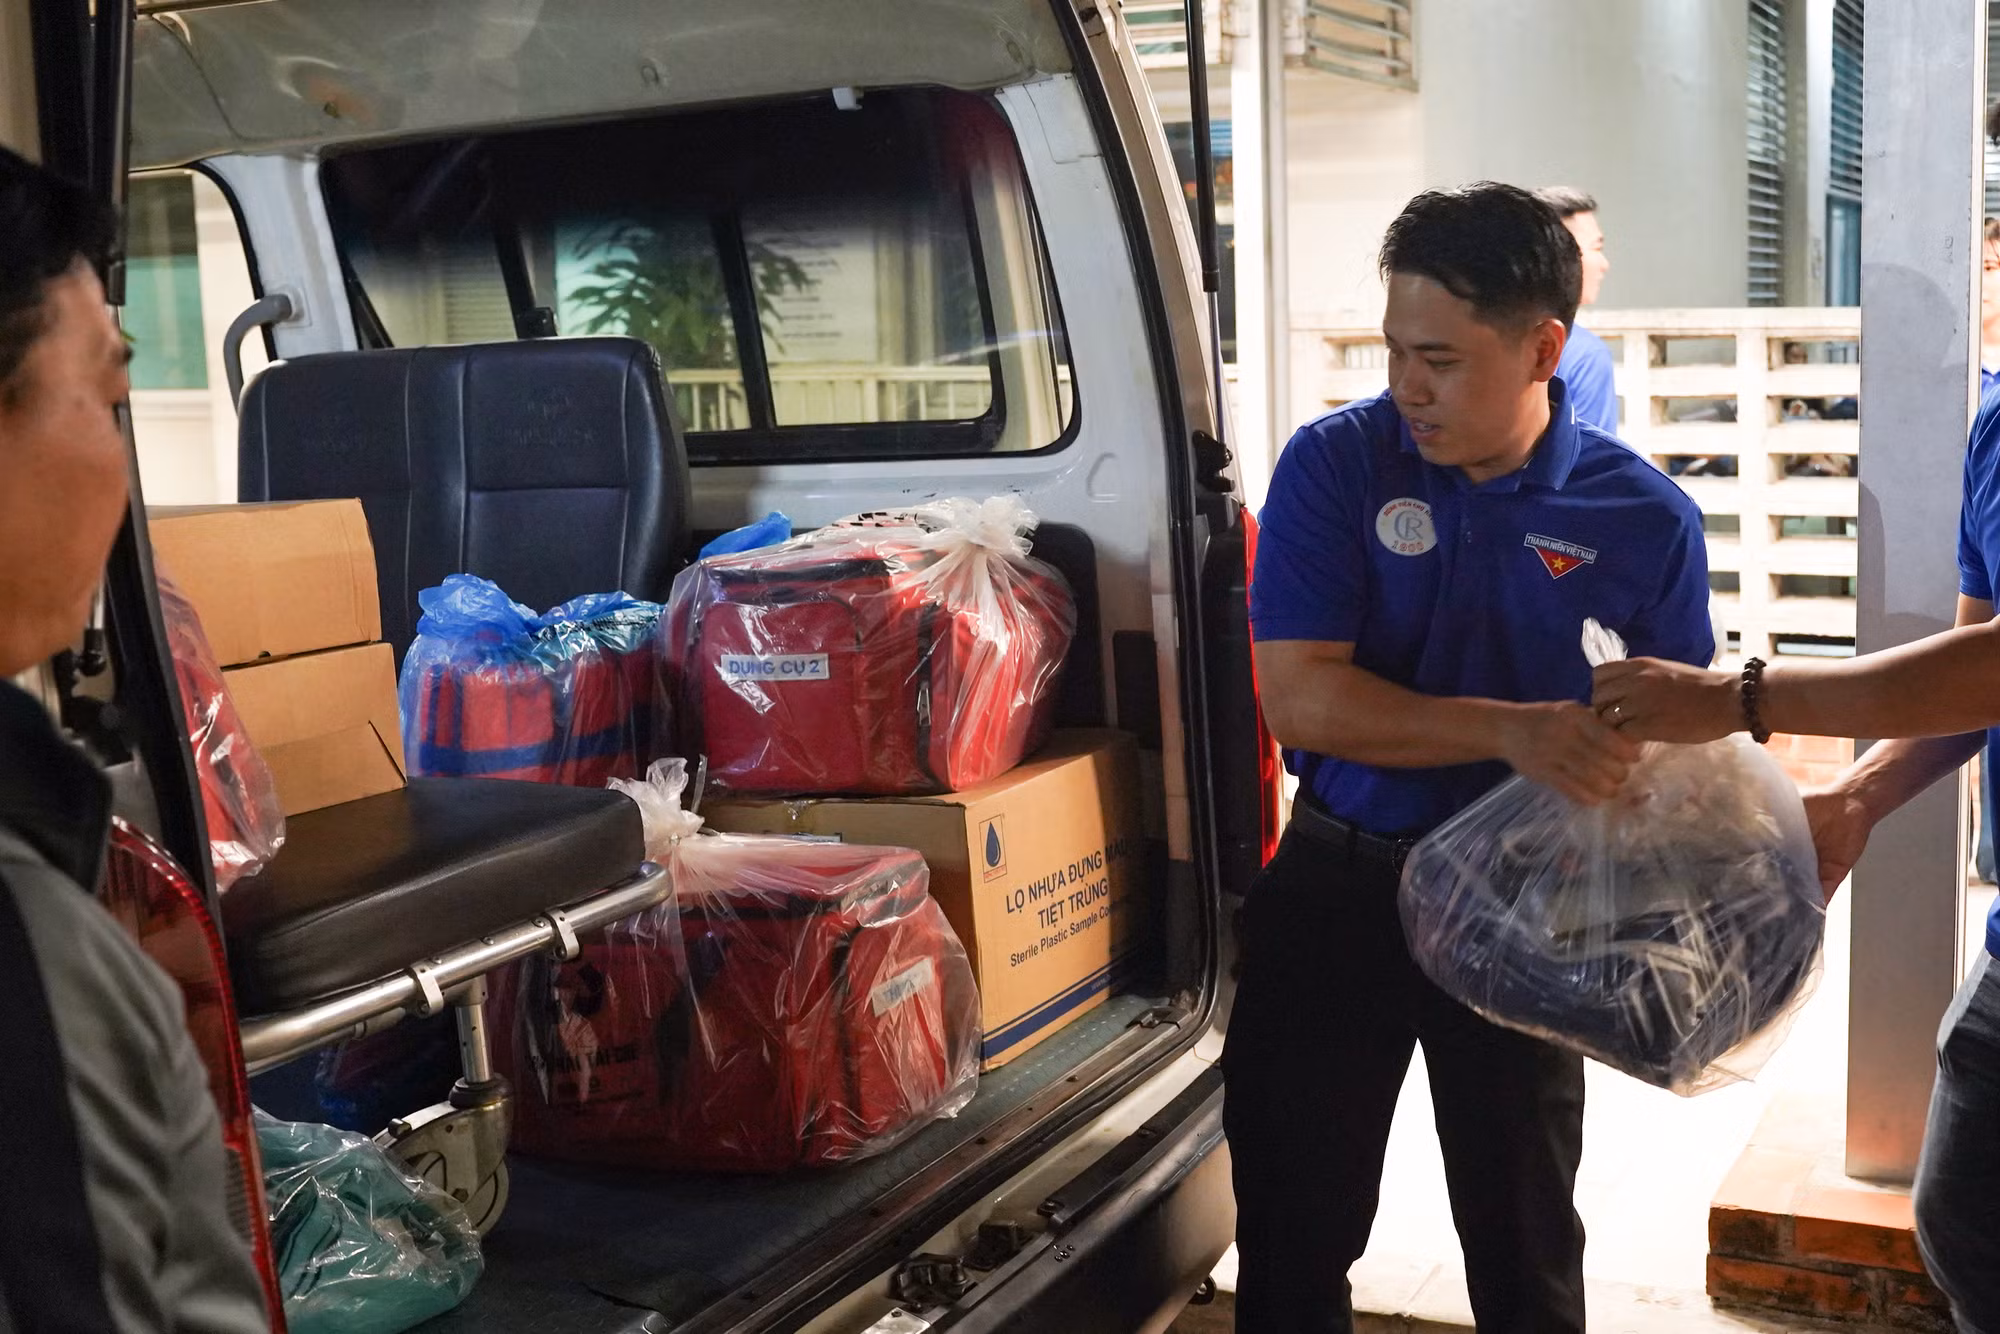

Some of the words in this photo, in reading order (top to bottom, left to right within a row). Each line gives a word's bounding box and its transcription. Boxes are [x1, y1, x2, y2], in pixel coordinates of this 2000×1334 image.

[1527, 536, 1550, 548] THANH
[1580, 551, 1595, 560] NAM
[781, 660, 806, 677] CỤ
[810, 659, 820, 673] 2
[1006, 888, 1025, 914] LỌ
[1028, 869, 1066, 904] NHỰA
[1068, 850, 1103, 883] ĐỰNG
[1037, 899, 1066, 929] TIỆT
[1068, 877, 1109, 914] TRÙNG
[1010, 944, 1039, 968] Sterile
[1040, 928, 1069, 952] Plastic
[1069, 911, 1098, 936] Sample
